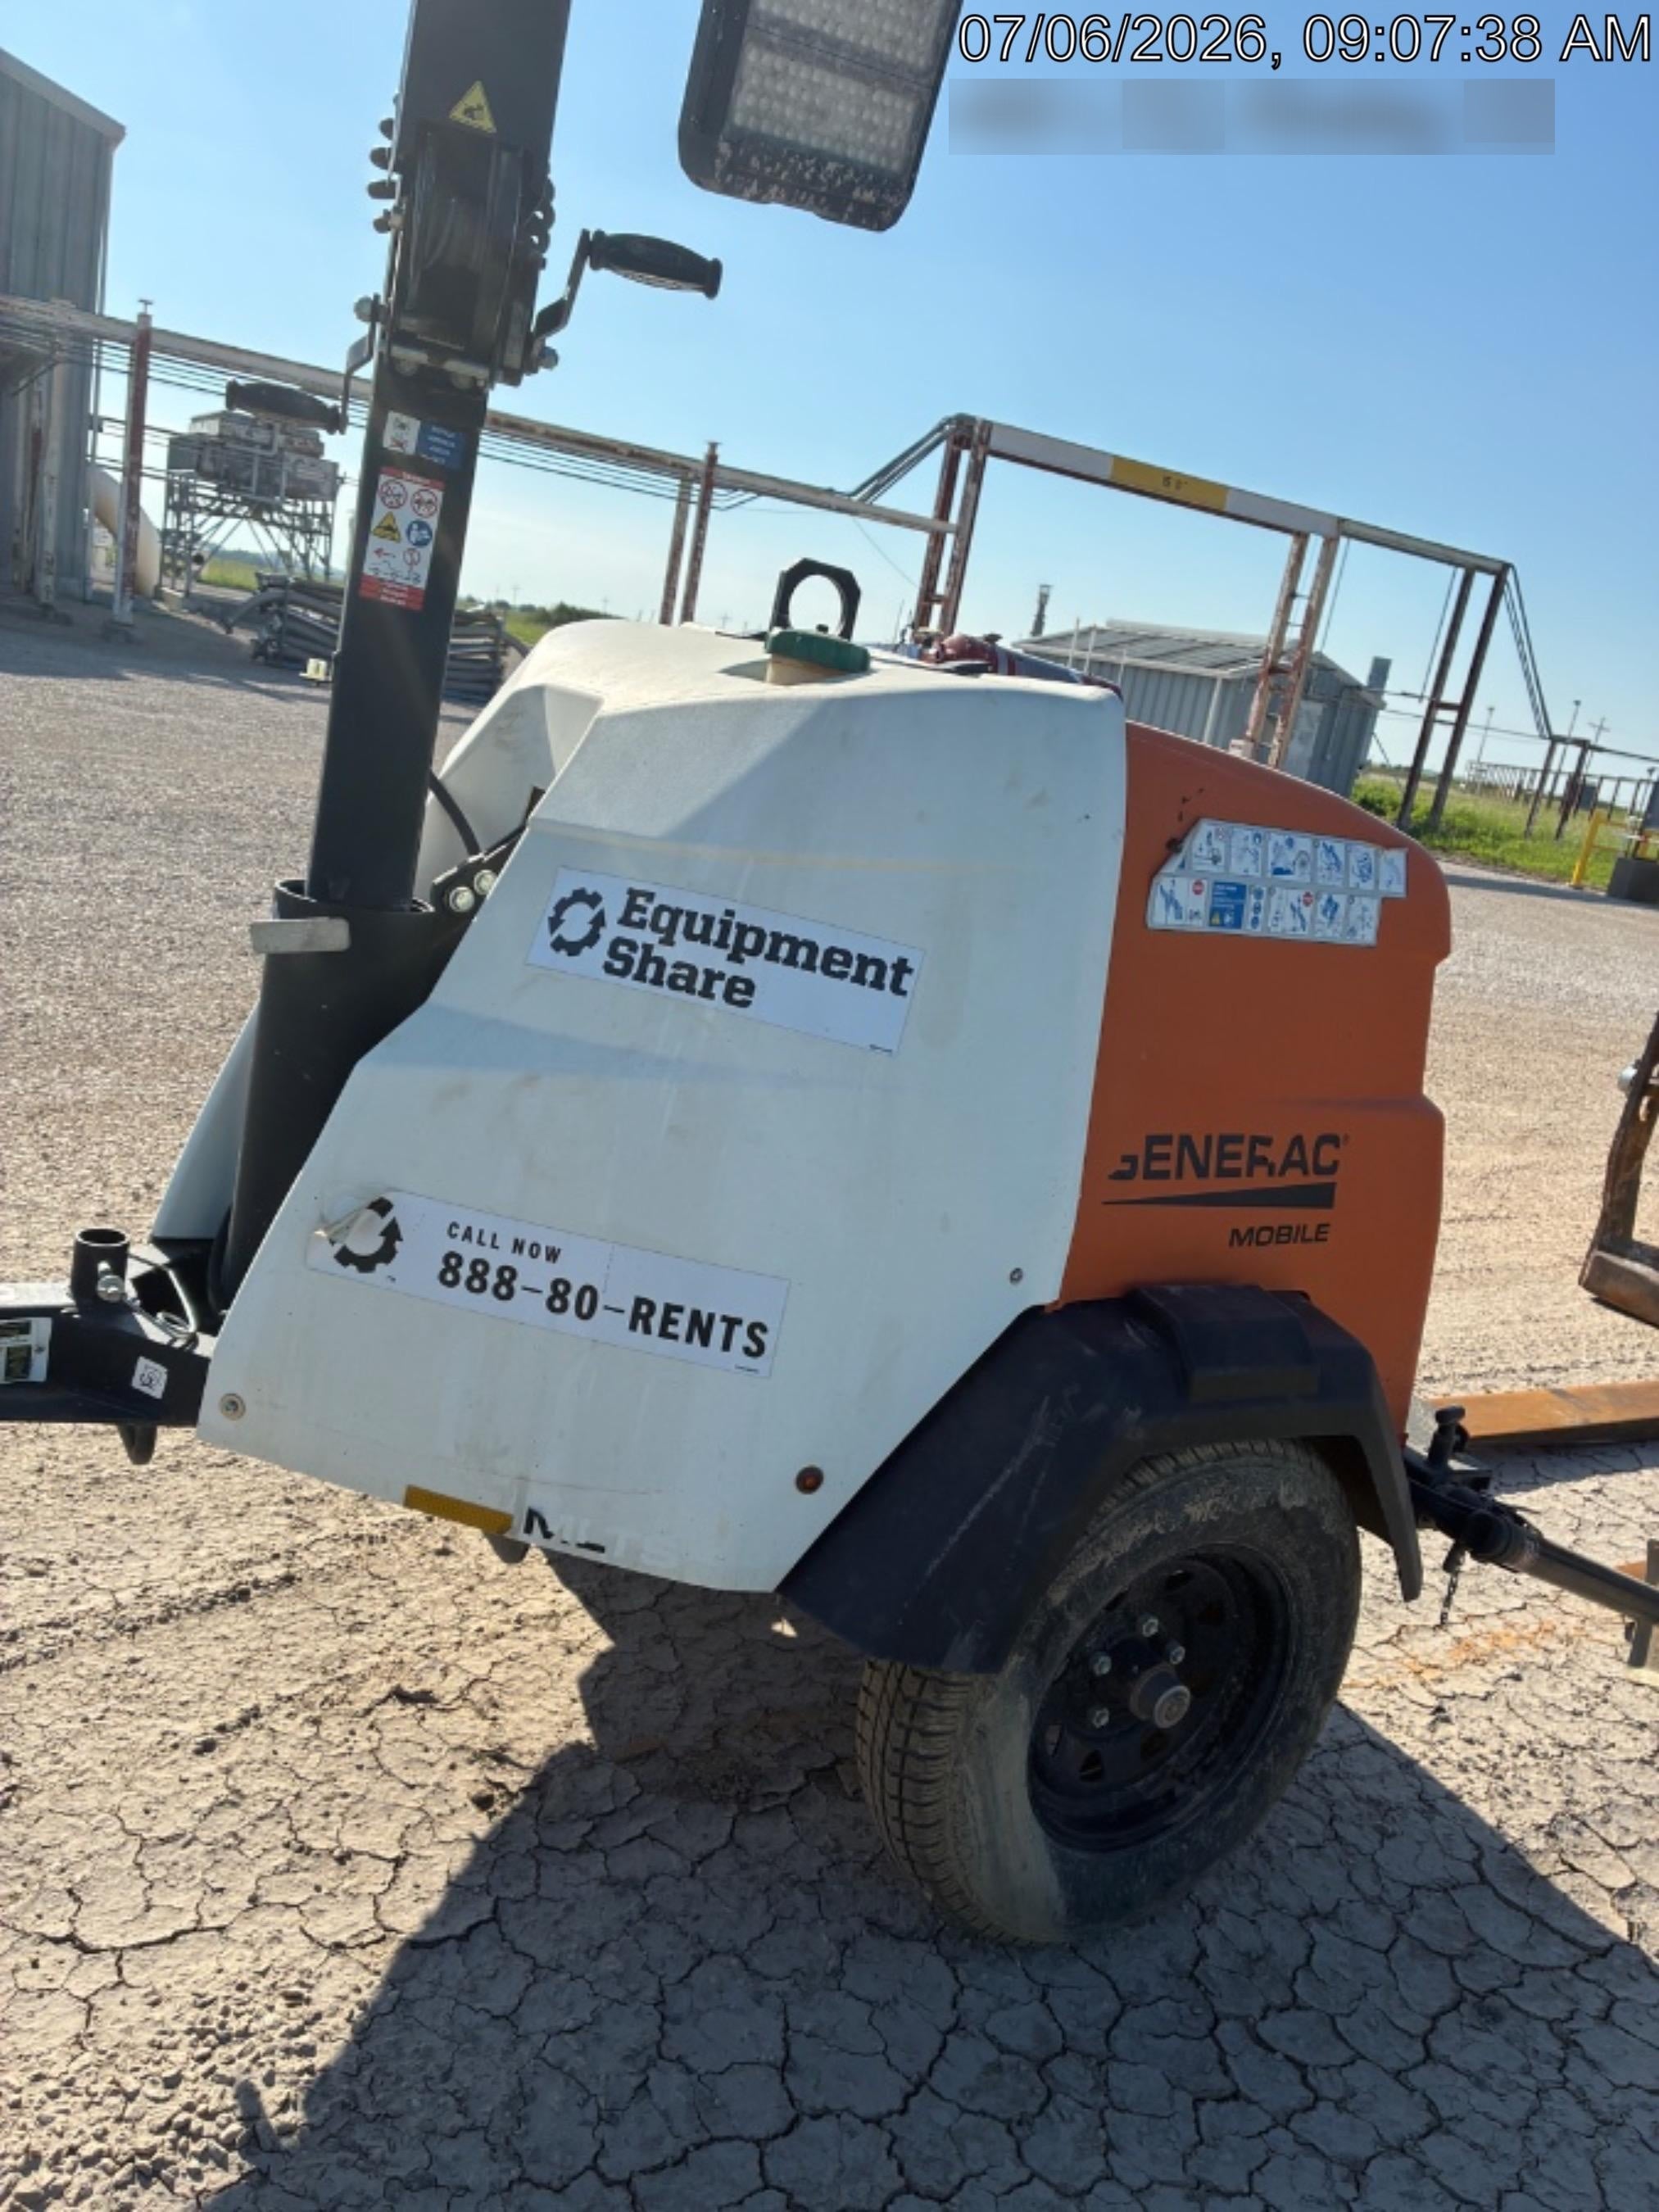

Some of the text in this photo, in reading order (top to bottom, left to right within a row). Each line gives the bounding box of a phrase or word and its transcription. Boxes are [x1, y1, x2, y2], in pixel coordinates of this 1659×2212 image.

[617, 886, 914, 997] Equipment
[602, 936, 755, 1009] Share
[1108, 1133, 1341, 1181] GENERAC
[446, 1221, 562, 1264] CALL NOW
[1228, 1222, 1331, 1248] MOBILE
